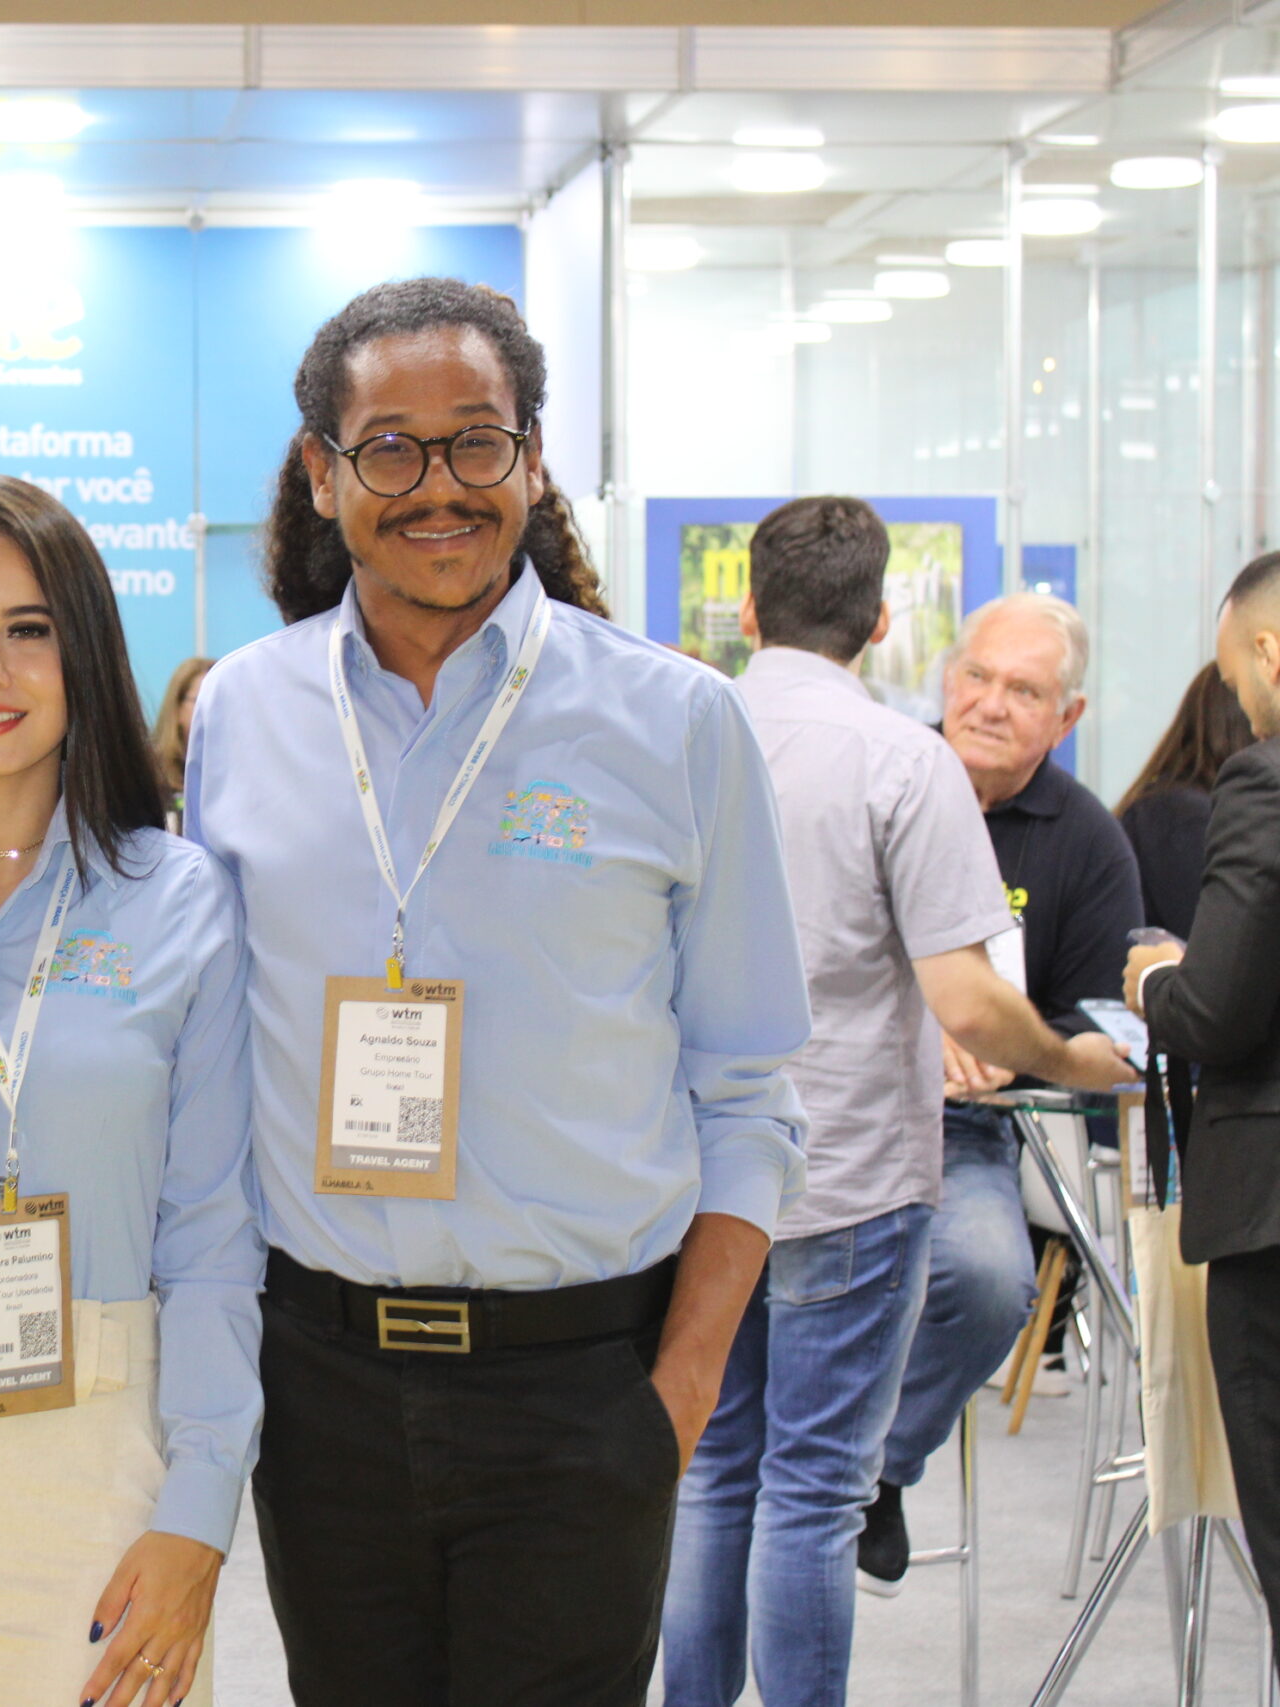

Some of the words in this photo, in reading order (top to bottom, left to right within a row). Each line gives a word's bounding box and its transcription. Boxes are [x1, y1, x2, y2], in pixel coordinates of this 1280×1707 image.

[76, 466, 154, 504] você
[425, 983, 456, 995] wtm
[392, 1007, 423, 1020] wtm
[360, 1033, 403, 1046] Agnaldo
[406, 1036, 437, 1047] Souza
[360, 1066, 385, 1077] Grupo
[387, 1069, 412, 1078] Home
[414, 1070, 433, 1080] Tour
[350, 1154, 391, 1166] TRAVEL
[393, 1157, 431, 1169] AGENT
[38, 1199, 65, 1212] wtm
[4, 1227, 31, 1240] wtm
[20, 1370, 52, 1384] AGENT
